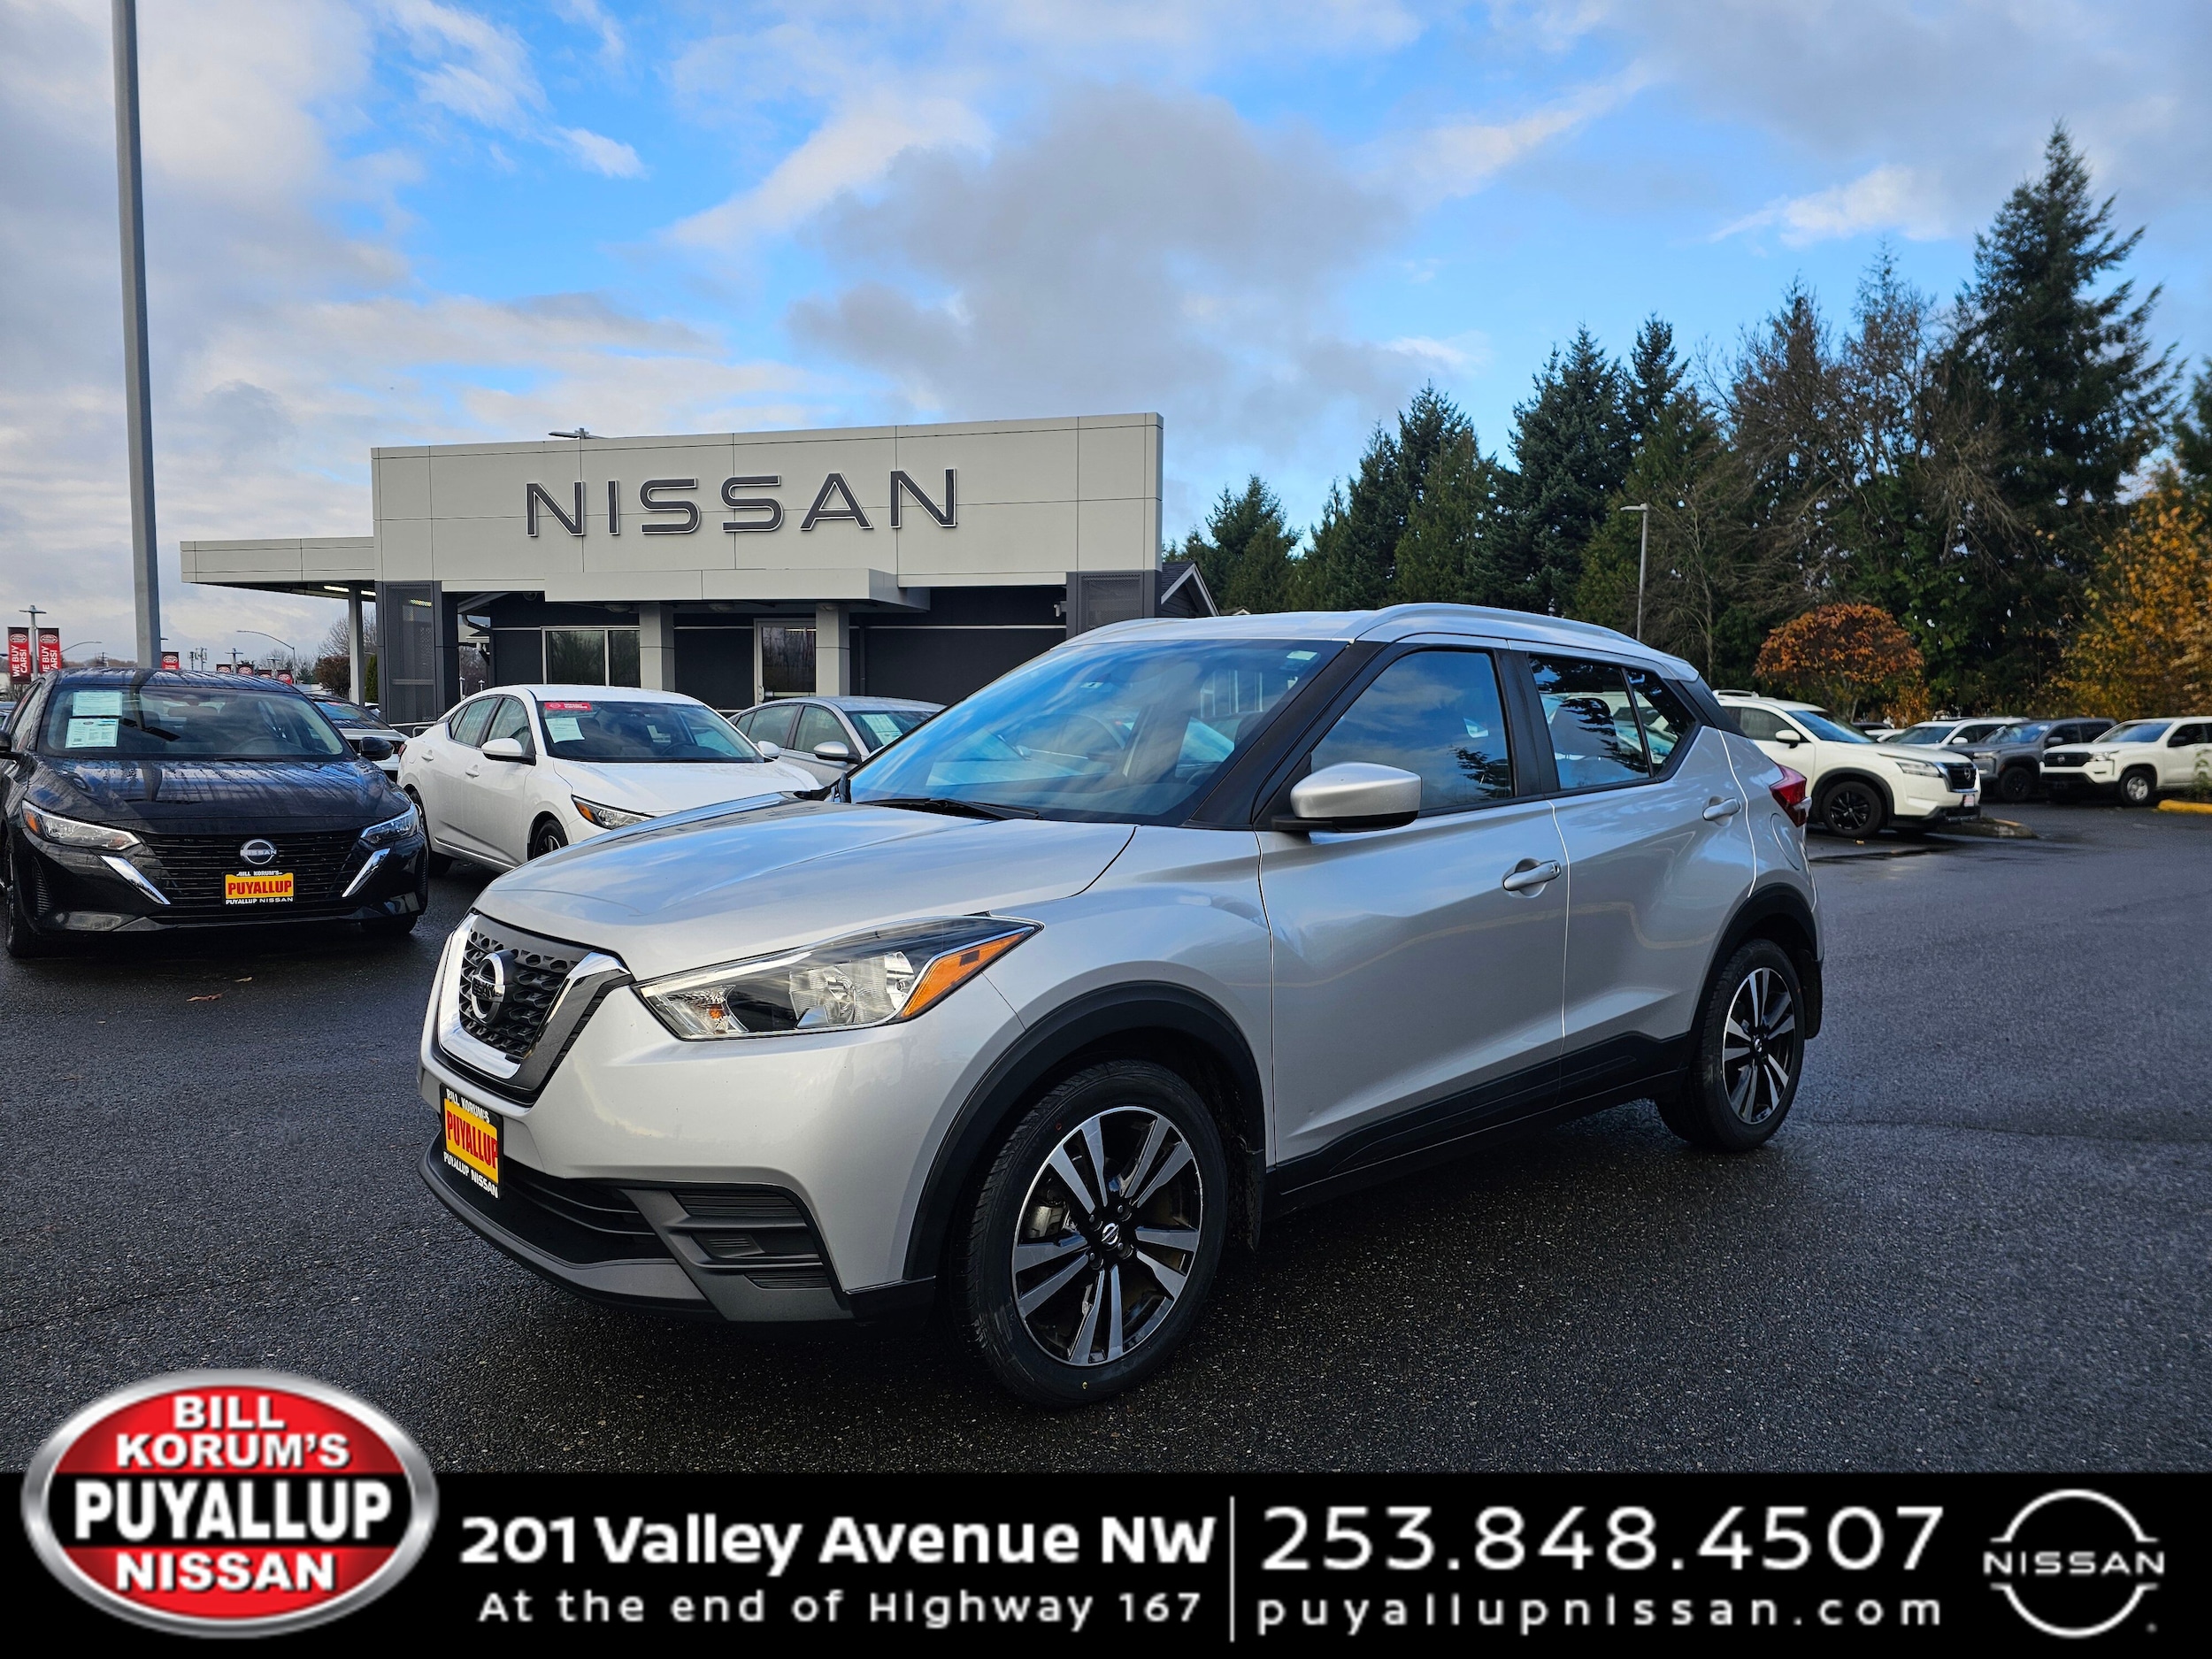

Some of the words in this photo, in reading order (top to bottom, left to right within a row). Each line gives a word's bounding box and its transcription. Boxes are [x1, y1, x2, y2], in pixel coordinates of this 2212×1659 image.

[526, 468, 957, 537] NISSAN
[11, 645, 19, 663] BUY
[19, 649, 28, 673] CARS!
[41, 646, 50, 664] BUY
[50, 649, 58, 670] ARS!
[12, 664, 20, 678] WE
[227, 879, 292, 895] PUYALLUP
[446, 1087, 460, 1107] BILL
[447, 1110, 498, 1170] PUYALLUP
[443, 1150, 470, 1177] PUYALLUP
[470, 1169, 499, 1199] NISSAN
